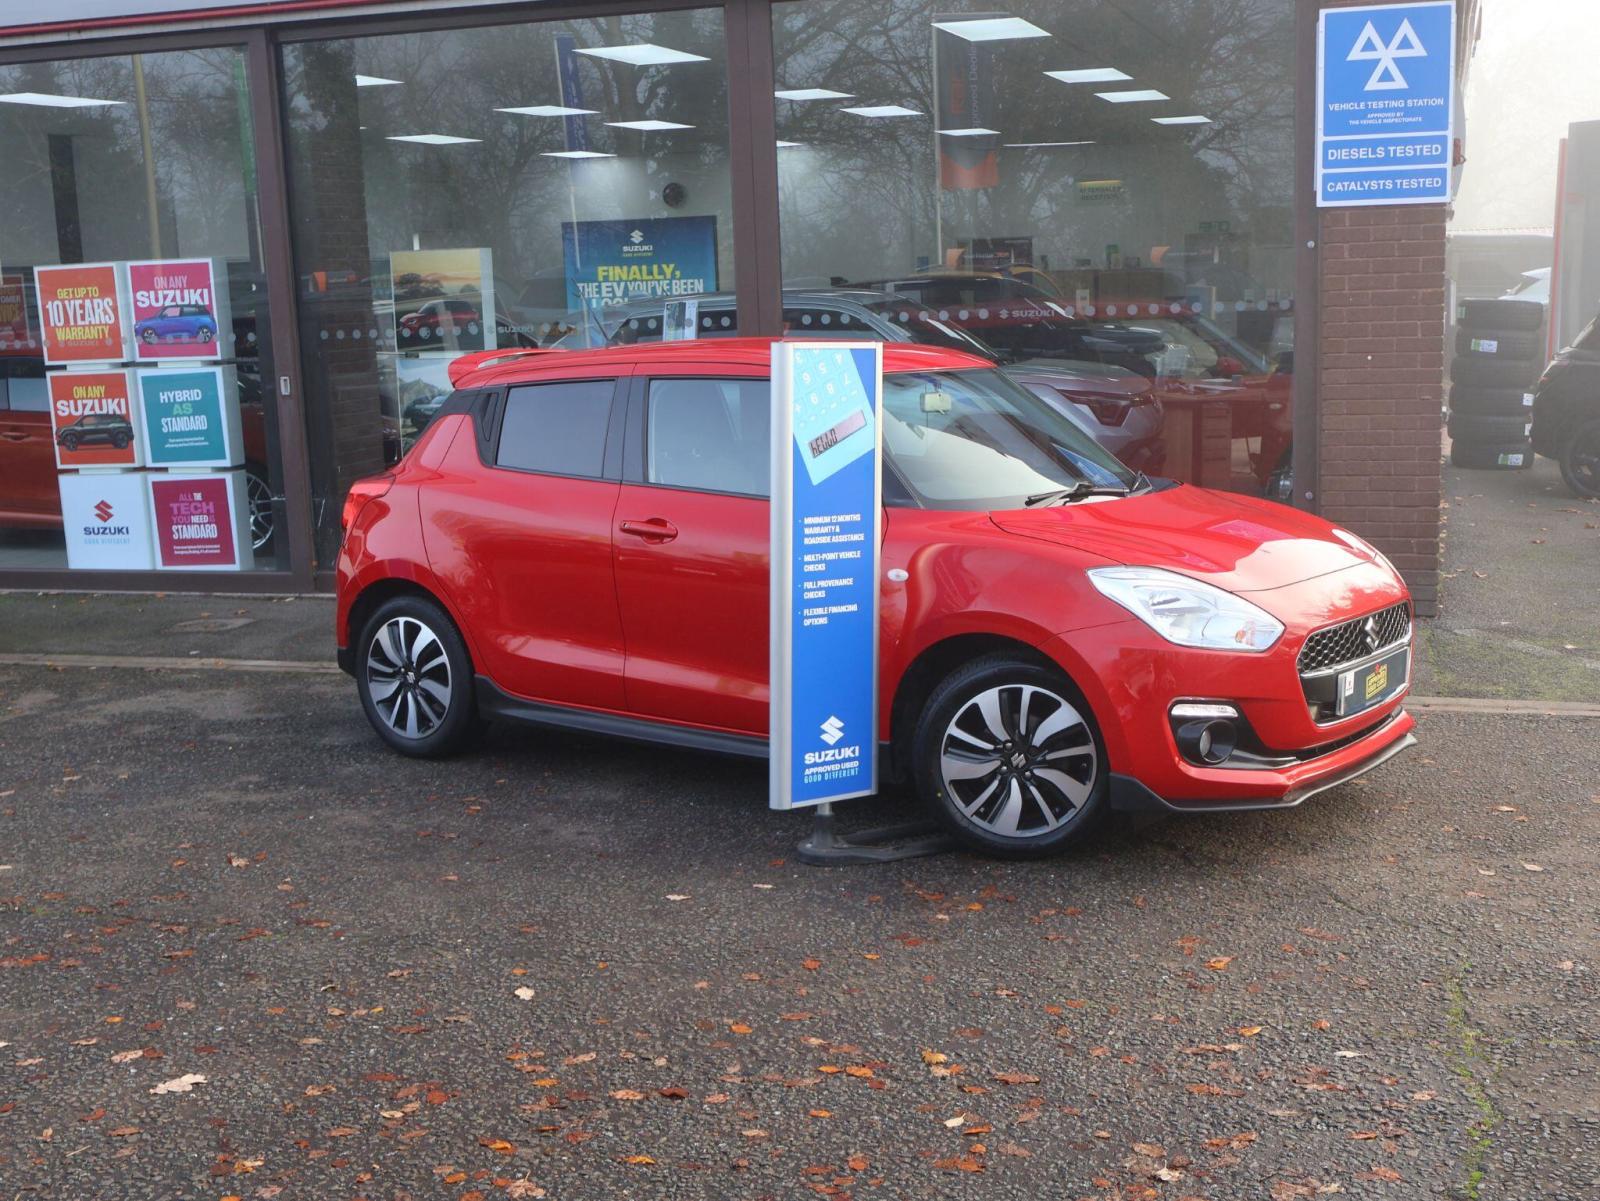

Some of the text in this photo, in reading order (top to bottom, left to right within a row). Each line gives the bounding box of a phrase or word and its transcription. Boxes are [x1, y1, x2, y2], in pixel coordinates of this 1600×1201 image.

[1328, 98, 1444, 111] VEHICLE TESTING STATION
[1328, 144, 1441, 160] DIESELS TESTED
[1327, 177, 1441, 192] CATALYSTS TESTED
[597, 263, 681, 281] FINALLY,
[154, 275, 188, 289] ON ANY
[577, 282, 599, 298] THE
[601, 281, 625, 297] EV
[672, 279, 704, 293] BEEN
[56, 286, 99, 300] GET UP TO
[136, 288, 210, 308] SUZUKI
[46, 301, 64, 327] 10
[64, 297, 115, 325] YEARS
[1011, 309, 1055, 318] SUZUKI
[55, 325, 109, 340] WARRANTY
[73, 385, 105, 399] ON ANY
[159, 389, 202, 404] HYBRID
[56, 398, 127, 417] SUZUKI
[172, 403, 193, 415] AS
[161, 415, 208, 433] STANDARD
[179, 492, 203, 502] ALL THE
[169, 501, 215, 515] TECH
[171, 516, 191, 524] YOU
[191, 514, 209, 523] NEED
[803, 514, 861, 524] MINIMUM 12 MONTHS
[83, 526, 130, 536] SUZUKI
[172, 524, 218, 540] STANDARD
[803, 526, 836, 534] WARRANTY
[803, 533, 865, 545] ROADSIDE ASSISTANCE
[803, 550, 861, 562] MULTI-POINT VEHICLE
[803, 563, 826, 572] CHECKS
[803, 578, 853, 589] FULL PROVENANCE
[803, 590, 826, 599] CHECKS
[803, 603, 858, 616] FLEXIBLE FINANCING
[803, 617, 828, 626] OPTIONS
[804, 746, 859, 764] SUZUKI
[804, 760, 859, 775] APPROVED USED
[803, 767, 859, 784] GOOD DIFFERENT
